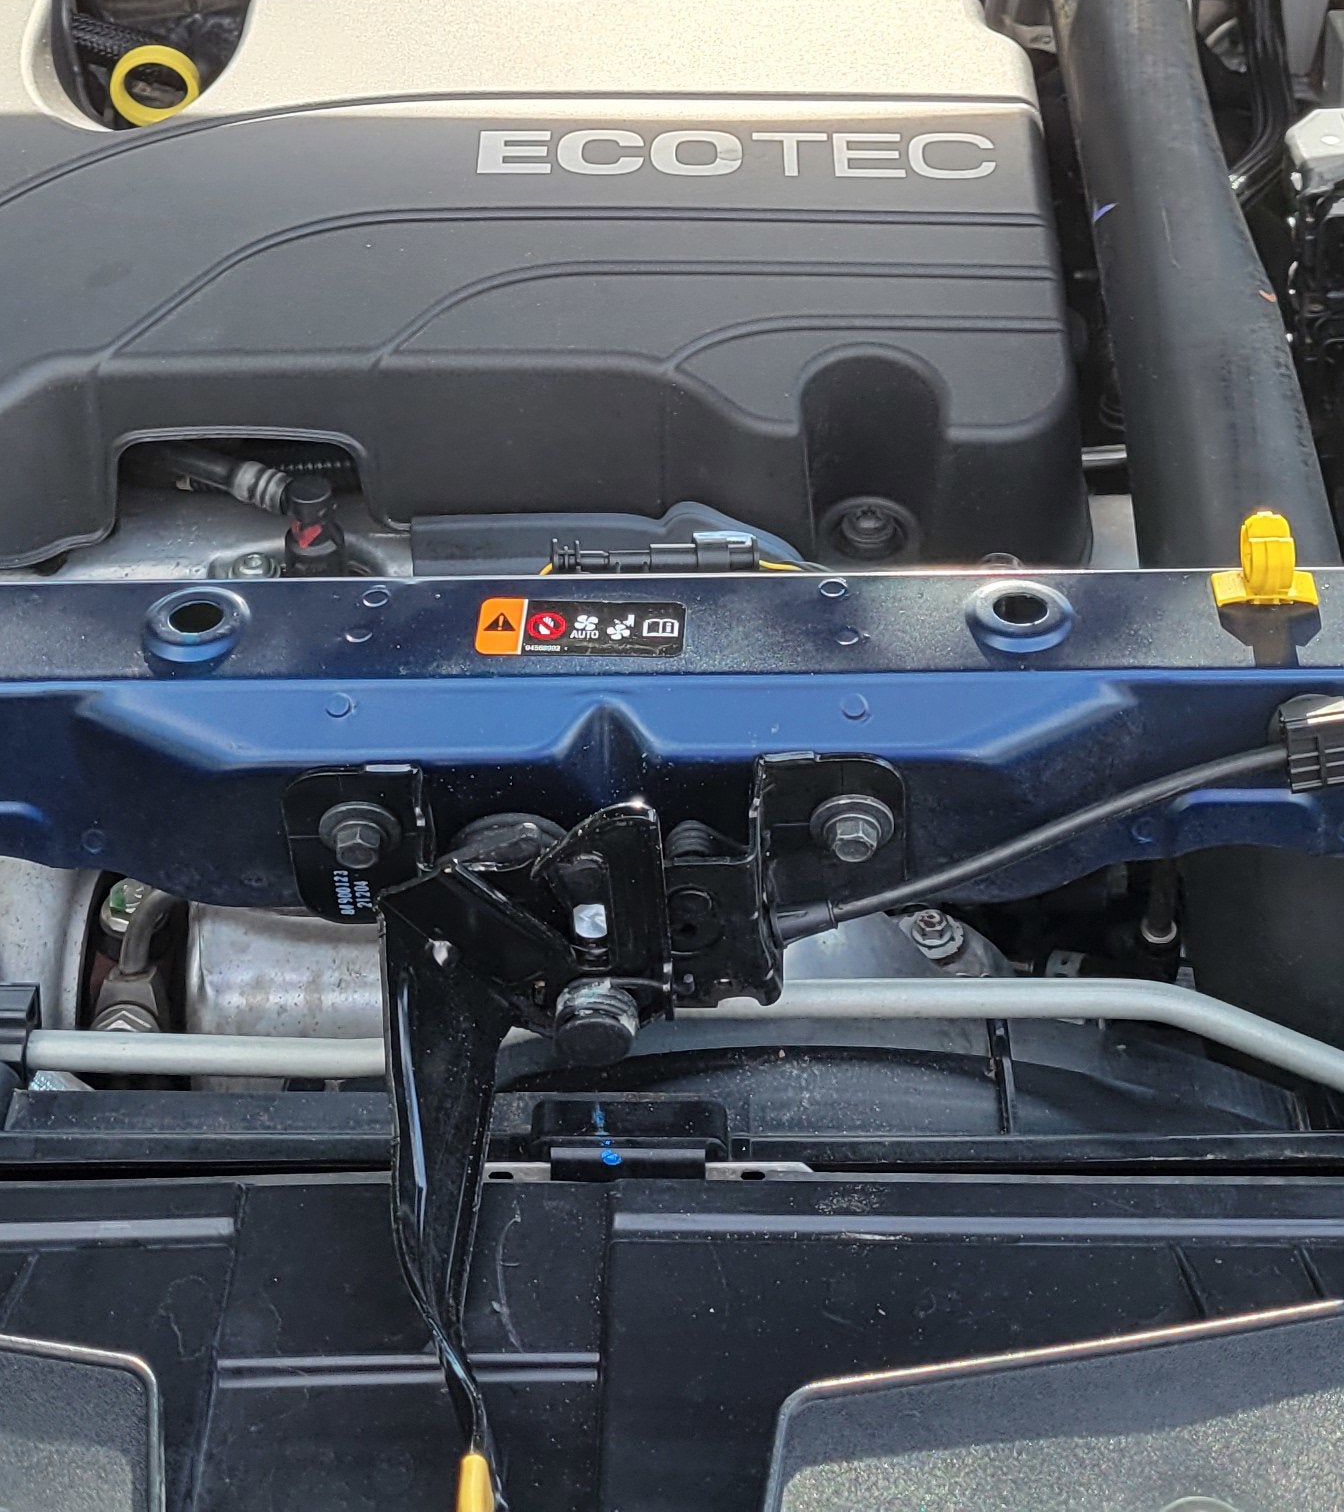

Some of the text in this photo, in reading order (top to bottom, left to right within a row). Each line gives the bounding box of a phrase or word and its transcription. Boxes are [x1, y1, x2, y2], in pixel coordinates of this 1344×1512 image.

[476, 129, 997, 180] ECOTEC
[569, 630, 599, 639] AUTO
[353, 880, 373, 908] 21204
